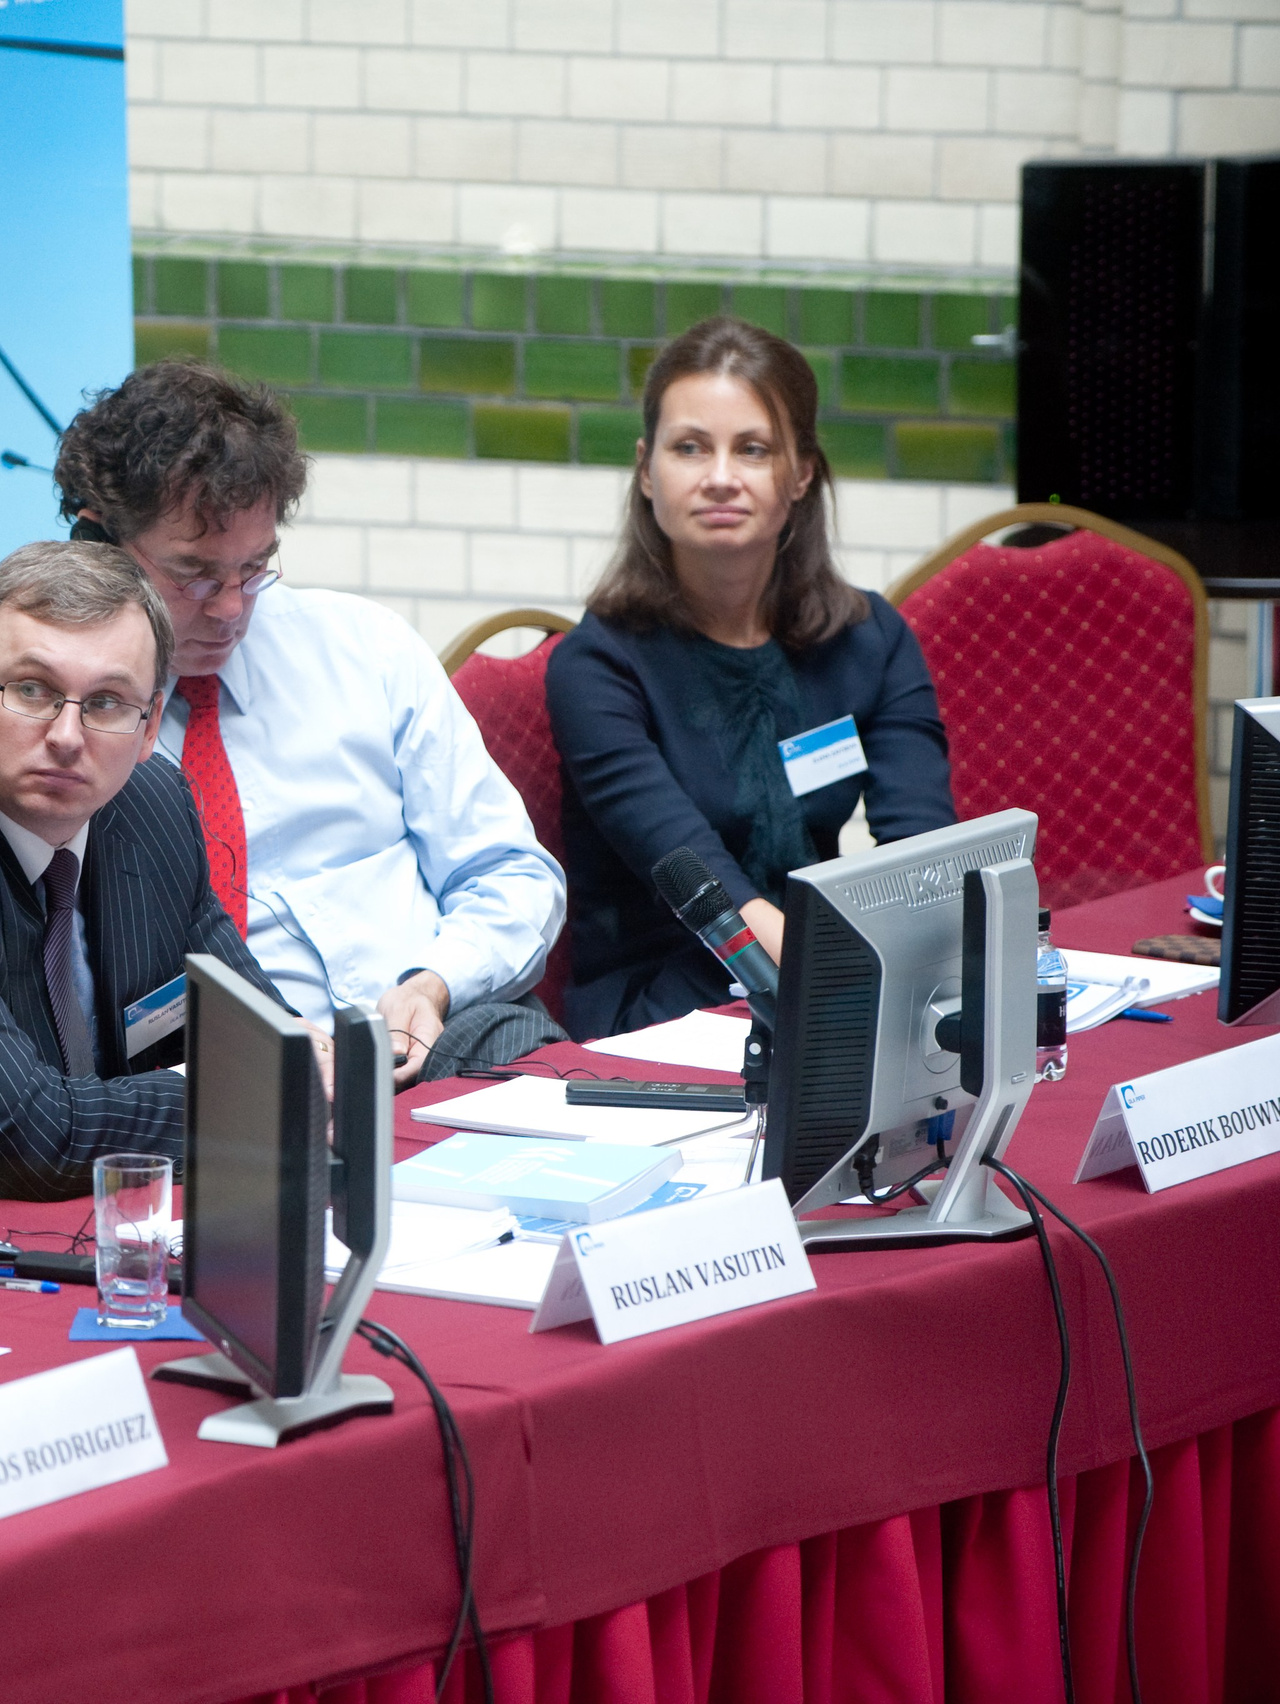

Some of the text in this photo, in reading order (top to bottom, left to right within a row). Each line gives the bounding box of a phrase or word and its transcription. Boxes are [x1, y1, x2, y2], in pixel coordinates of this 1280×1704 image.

[1137, 1119, 1220, 1165] RODERIK
[610, 1243, 786, 1310] RUSLAN VASUTIN
[25, 1413, 152, 1476] RODRIGUEZ
